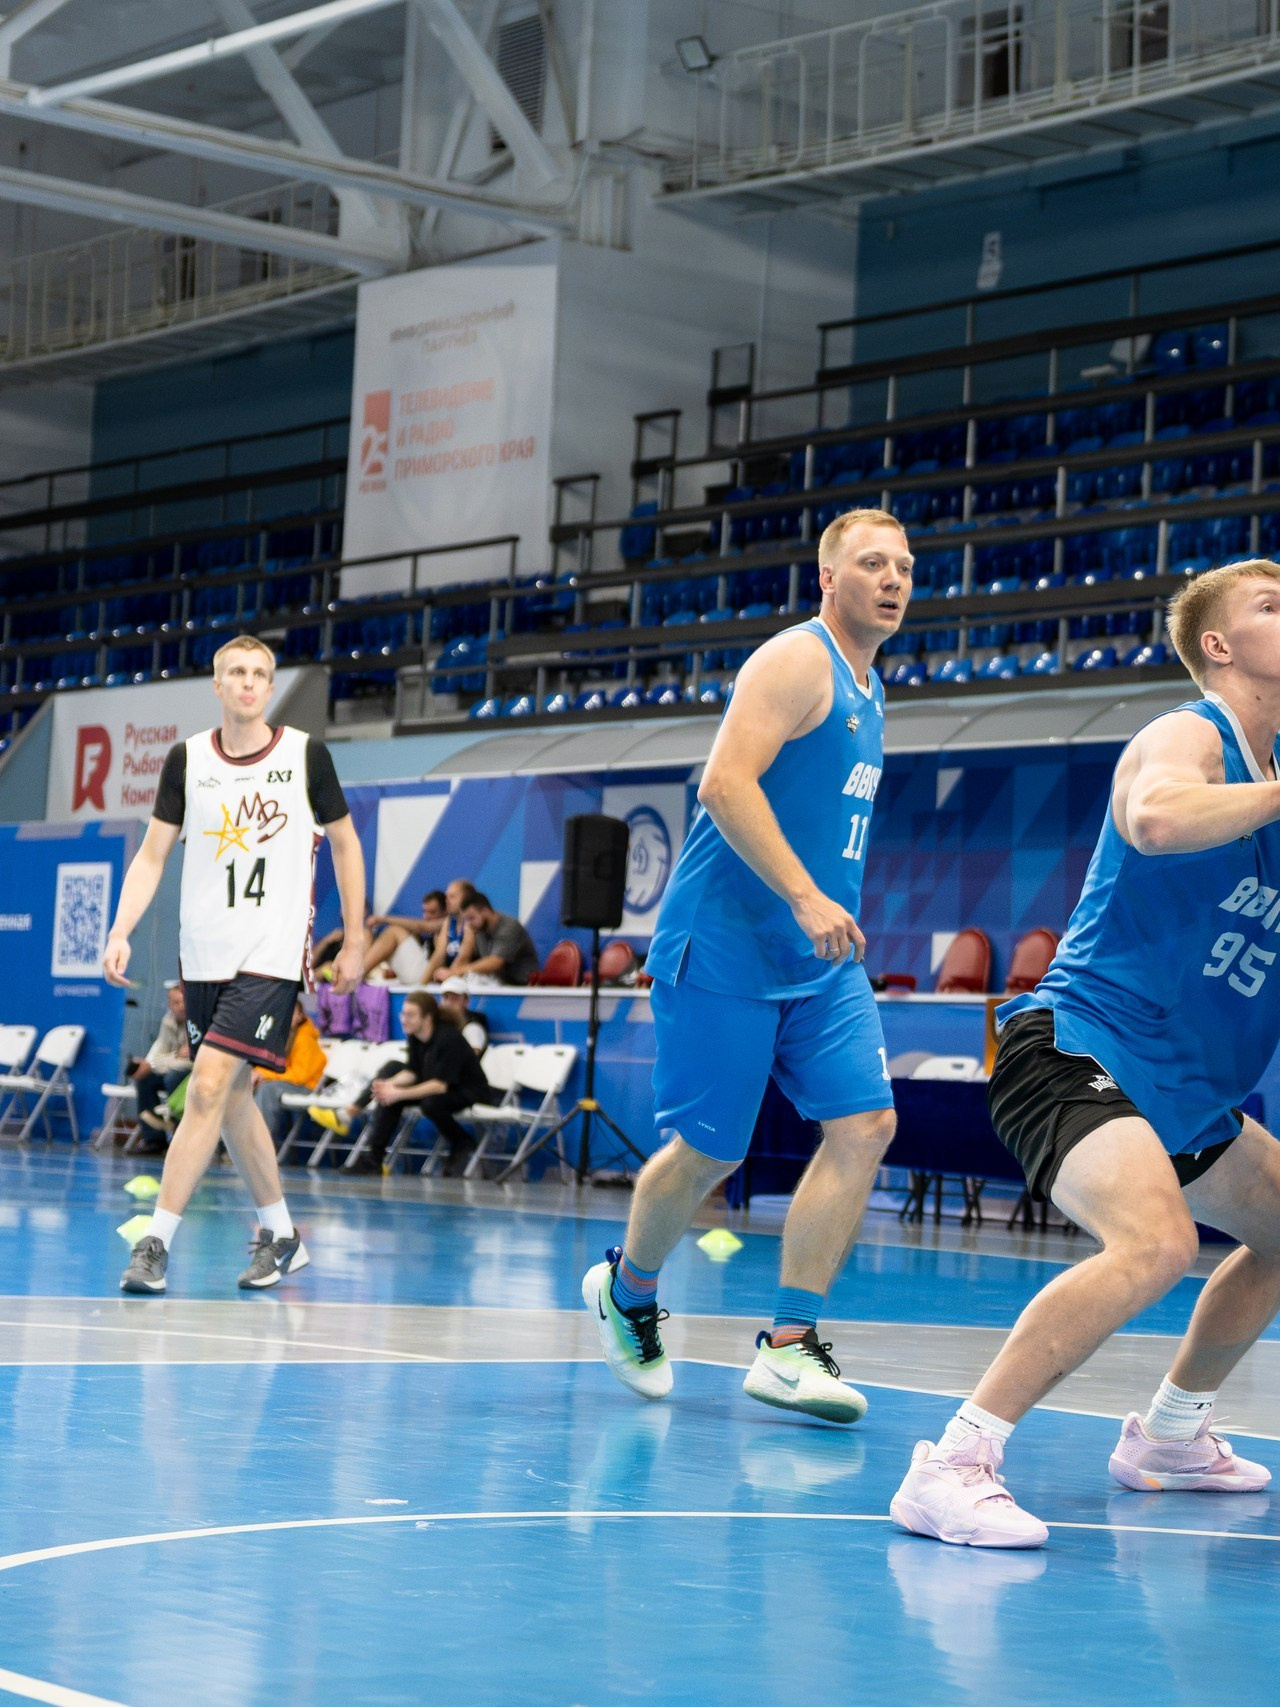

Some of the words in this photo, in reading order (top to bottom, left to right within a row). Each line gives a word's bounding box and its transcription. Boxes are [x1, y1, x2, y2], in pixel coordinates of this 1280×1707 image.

[125, 722, 178, 750] Русская
[123, 753, 165, 775] Рыбо
[121, 785, 156, 807] Комп
[841, 814, 868, 861] 11
[225, 857, 265, 908] 14
[1202, 931, 1277, 998] 95
